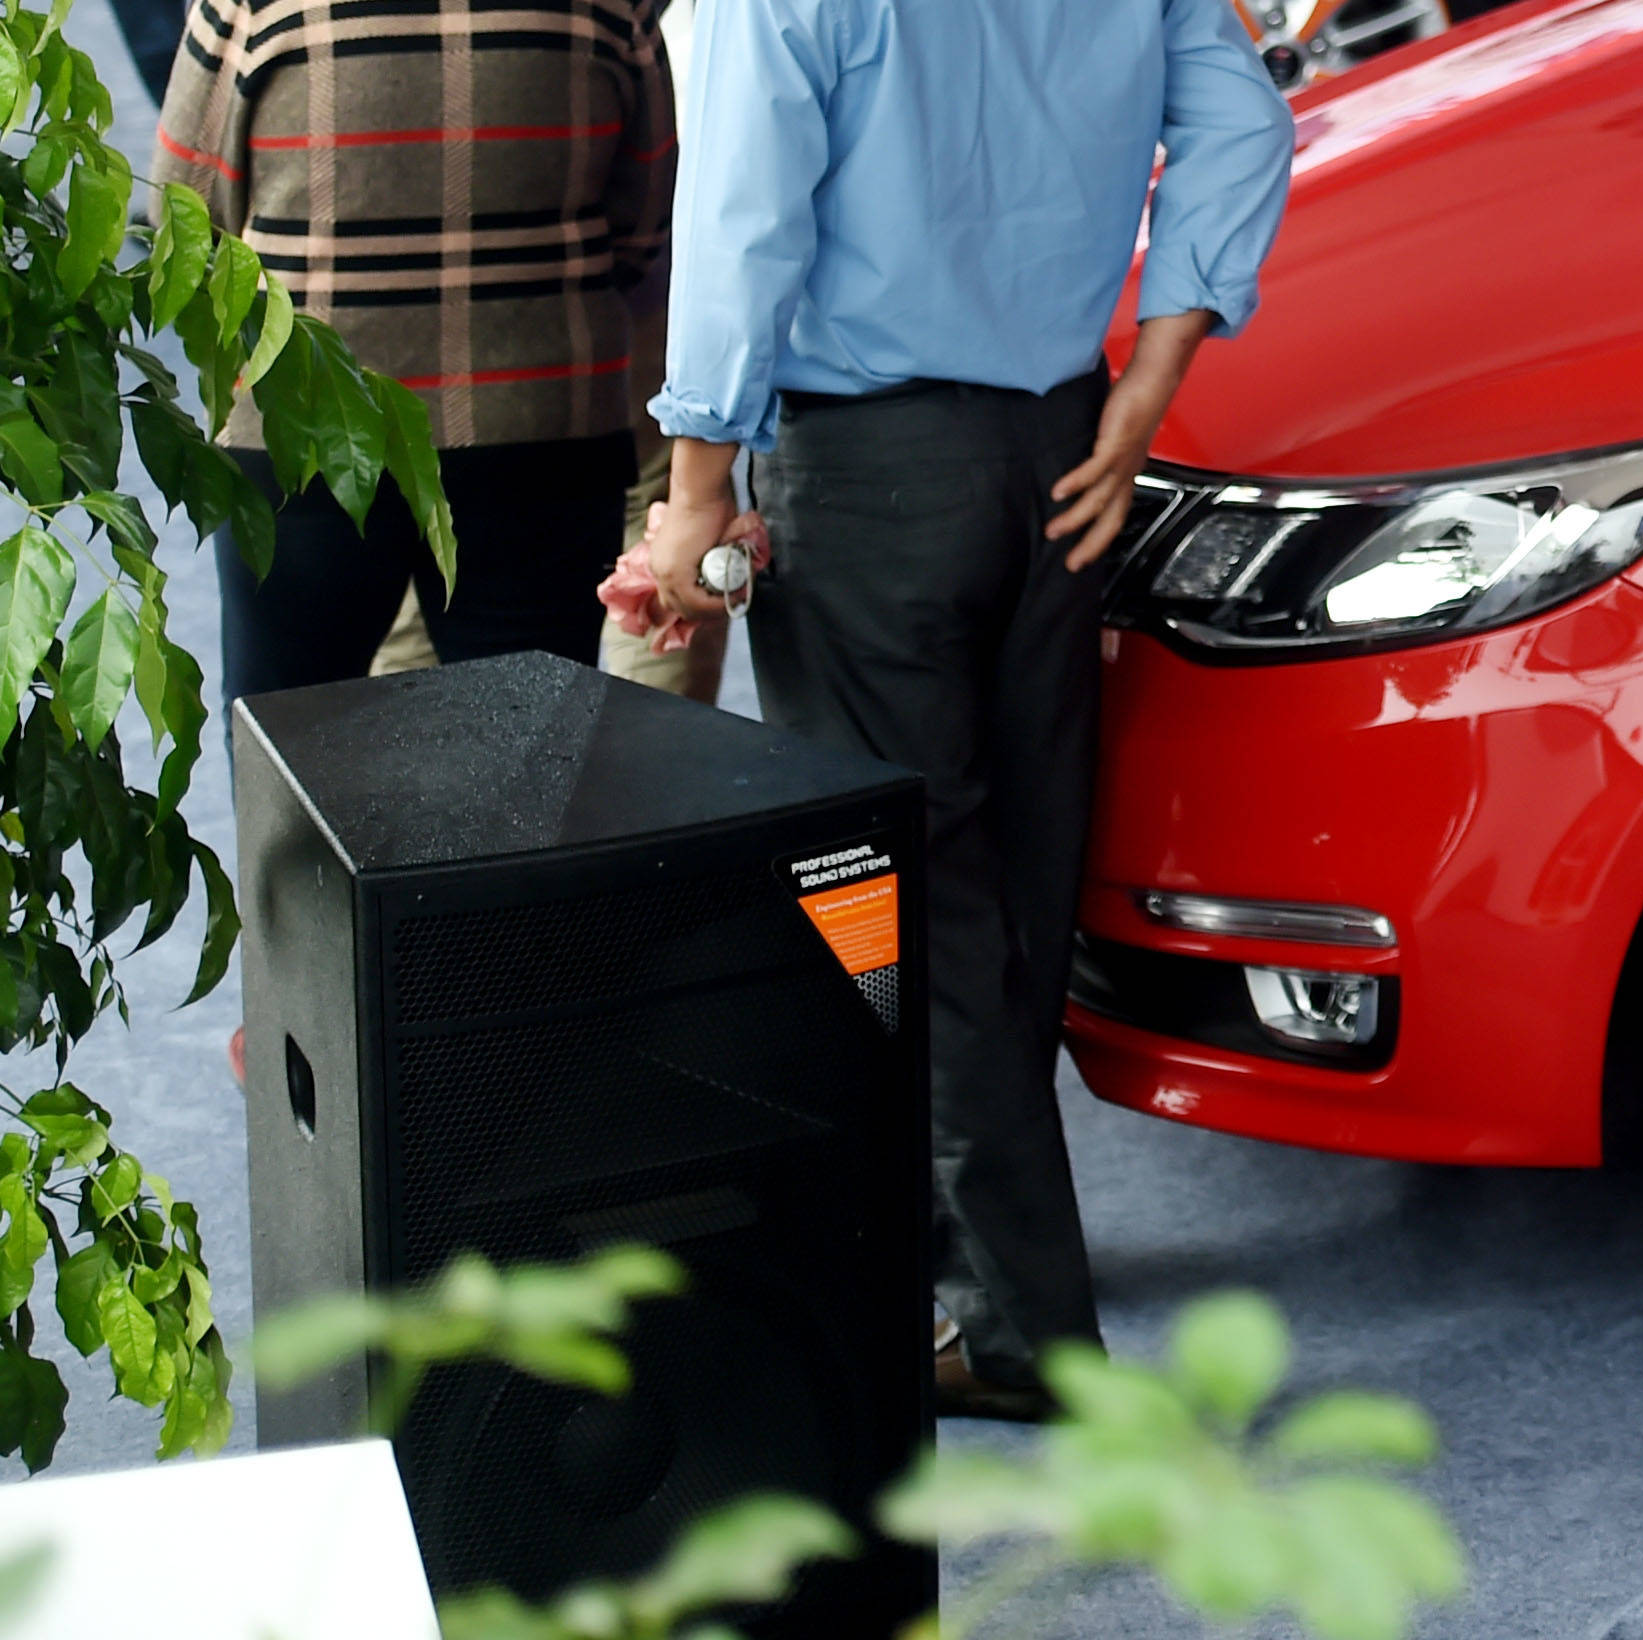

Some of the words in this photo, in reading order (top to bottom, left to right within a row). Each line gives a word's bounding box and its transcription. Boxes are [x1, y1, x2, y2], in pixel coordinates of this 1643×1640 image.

[791, 845, 875, 874] PROFESSIONAL
[800, 869, 838, 888] SOUND
[839, 855, 891, 878] SYSTEMS
